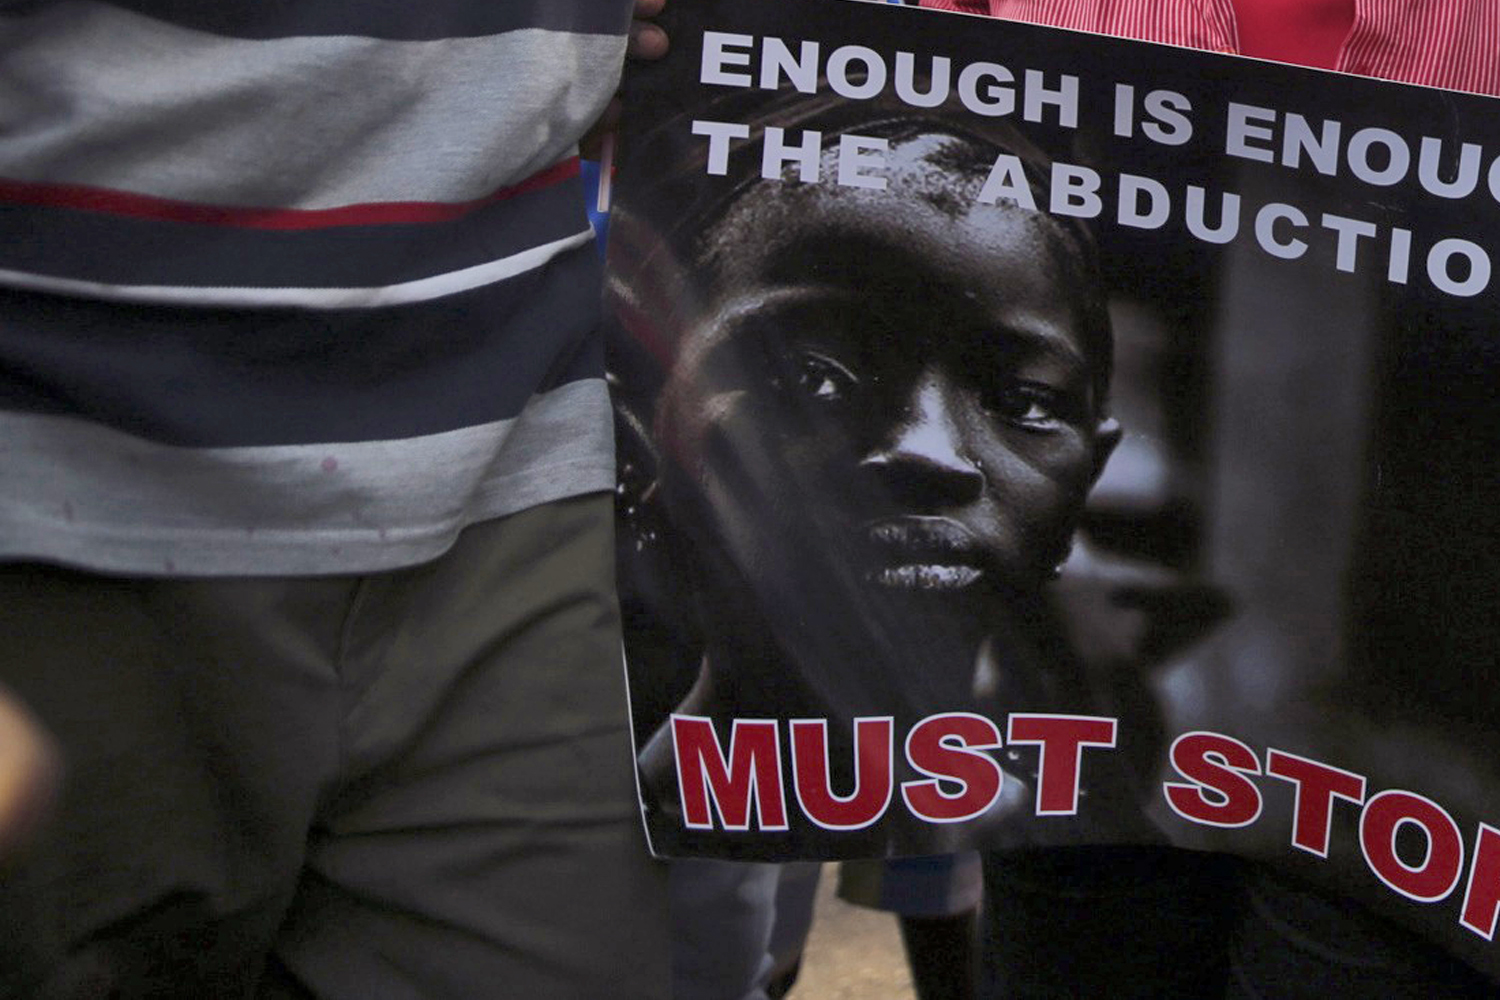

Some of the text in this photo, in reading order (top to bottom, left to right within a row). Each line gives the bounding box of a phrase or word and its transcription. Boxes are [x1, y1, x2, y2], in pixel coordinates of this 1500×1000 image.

[698, 31, 1079, 127] ENOUGH
[1113, 84, 1194, 146] IS
[691, 120, 888, 191] THE
[670, 712, 1118, 832] MUST
